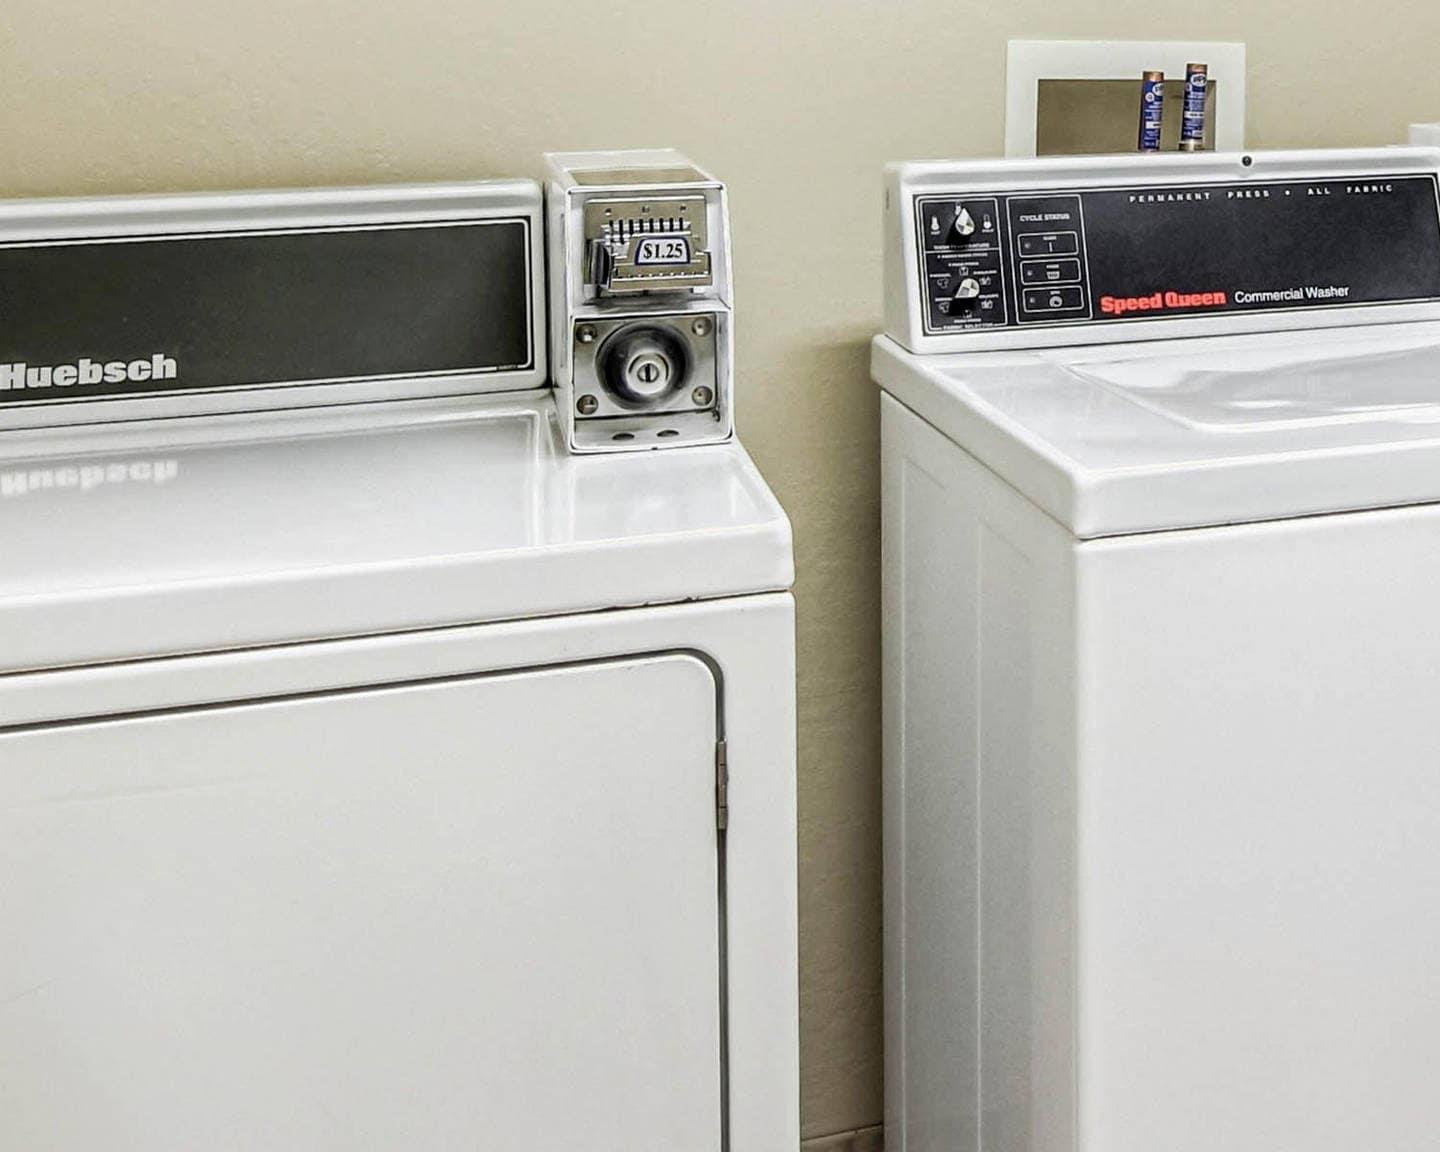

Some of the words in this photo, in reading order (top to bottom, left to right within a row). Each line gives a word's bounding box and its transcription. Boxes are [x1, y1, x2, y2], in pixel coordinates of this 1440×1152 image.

[1129, 192, 1211, 203] PERMANENT
[1227, 189, 1271, 199] PRESS
[1307, 187, 1331, 196] ALL
[1347, 184, 1394, 194] FABRIC
[643, 243, 683, 259] $1.25
[1100, 293, 1163, 315] Speed
[1165, 291, 1227, 308] Queen
[1234, 287, 1304, 304] Commercial
[1305, 285, 1350, 299] Washer
[0, 353, 177, 390] Huebsch
